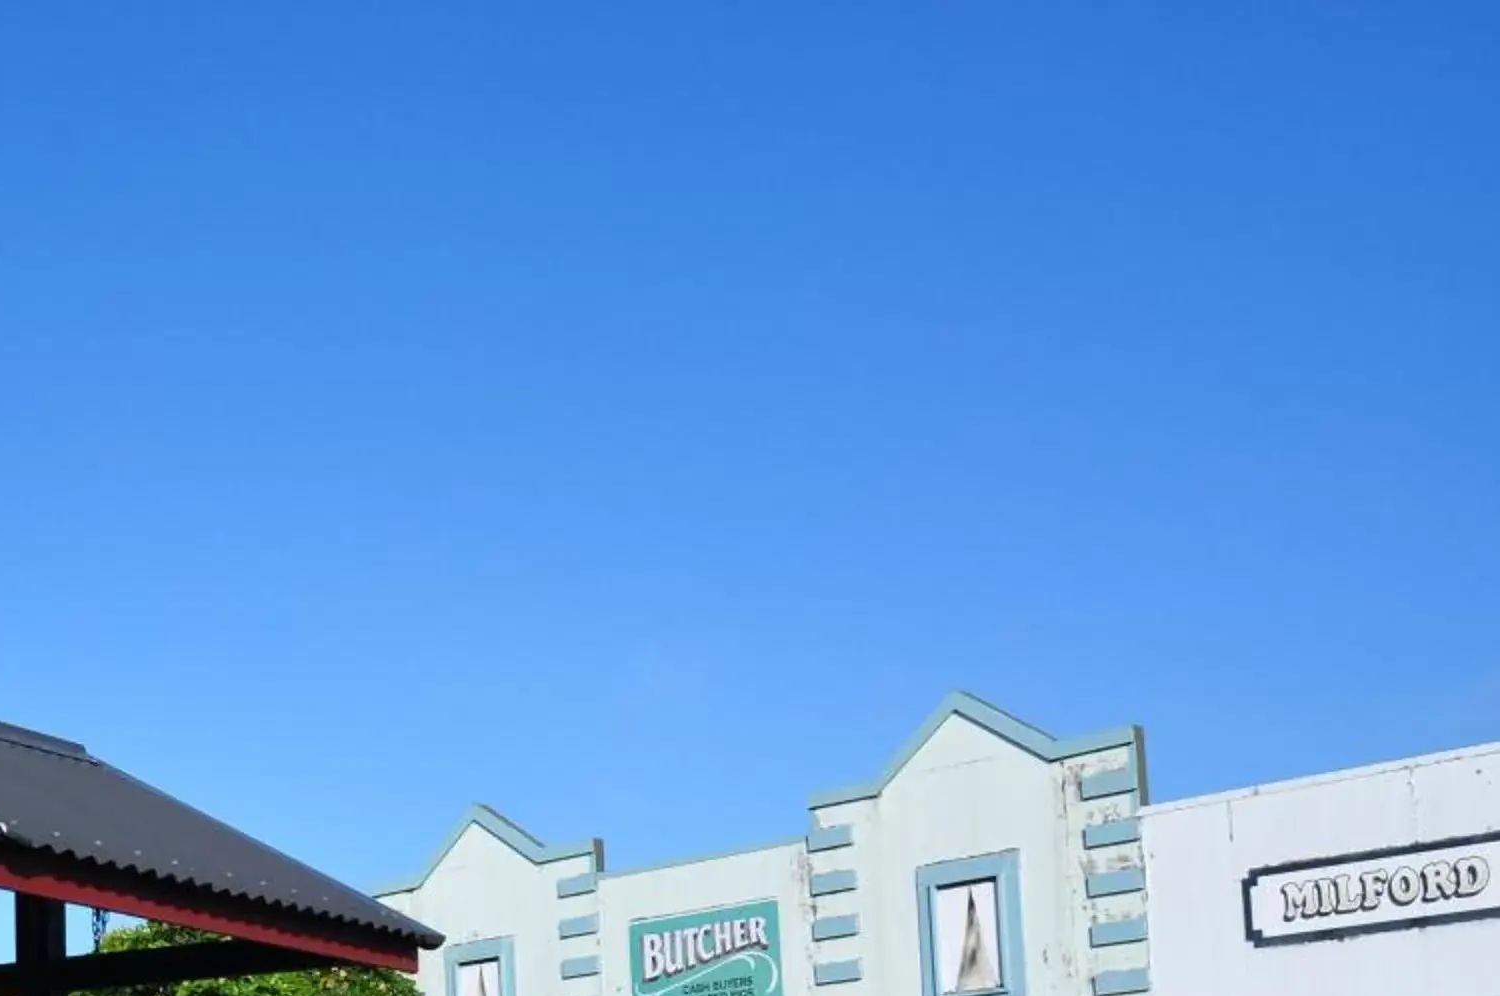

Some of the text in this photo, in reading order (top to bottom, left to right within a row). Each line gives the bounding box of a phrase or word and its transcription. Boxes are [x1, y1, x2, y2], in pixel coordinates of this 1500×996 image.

[1281, 856, 1490, 922] MILFORD
[642, 916, 769, 983] BUTCHER
[683, 976, 754, 995] CASH BUYERS
